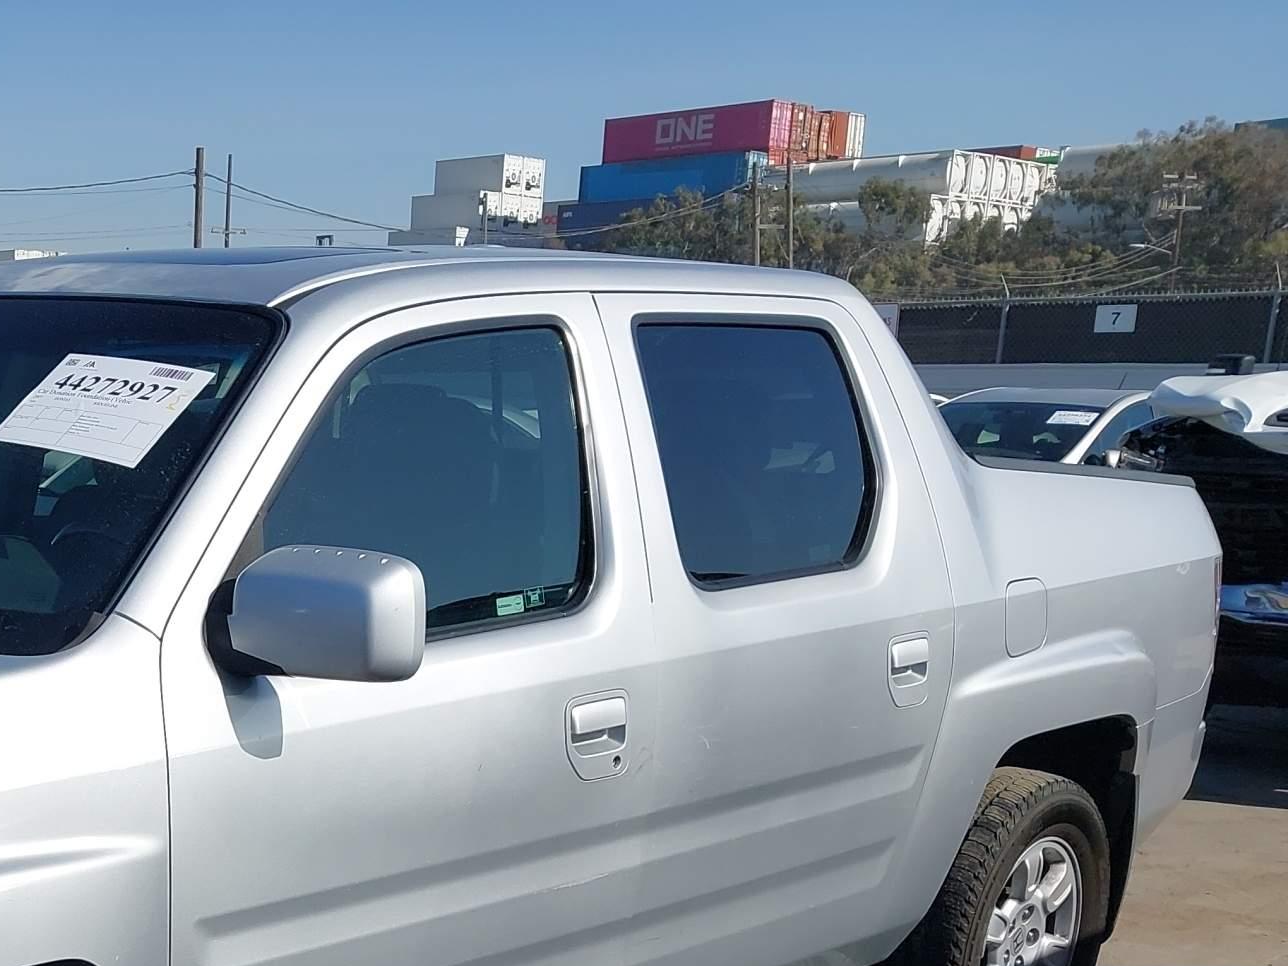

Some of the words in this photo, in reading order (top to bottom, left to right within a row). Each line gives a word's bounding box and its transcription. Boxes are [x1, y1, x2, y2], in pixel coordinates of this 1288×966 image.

[655, 114, 715, 144] ONE
[1112, 312, 1121, 326] 7
[54, 373, 178, 403] 44272927
